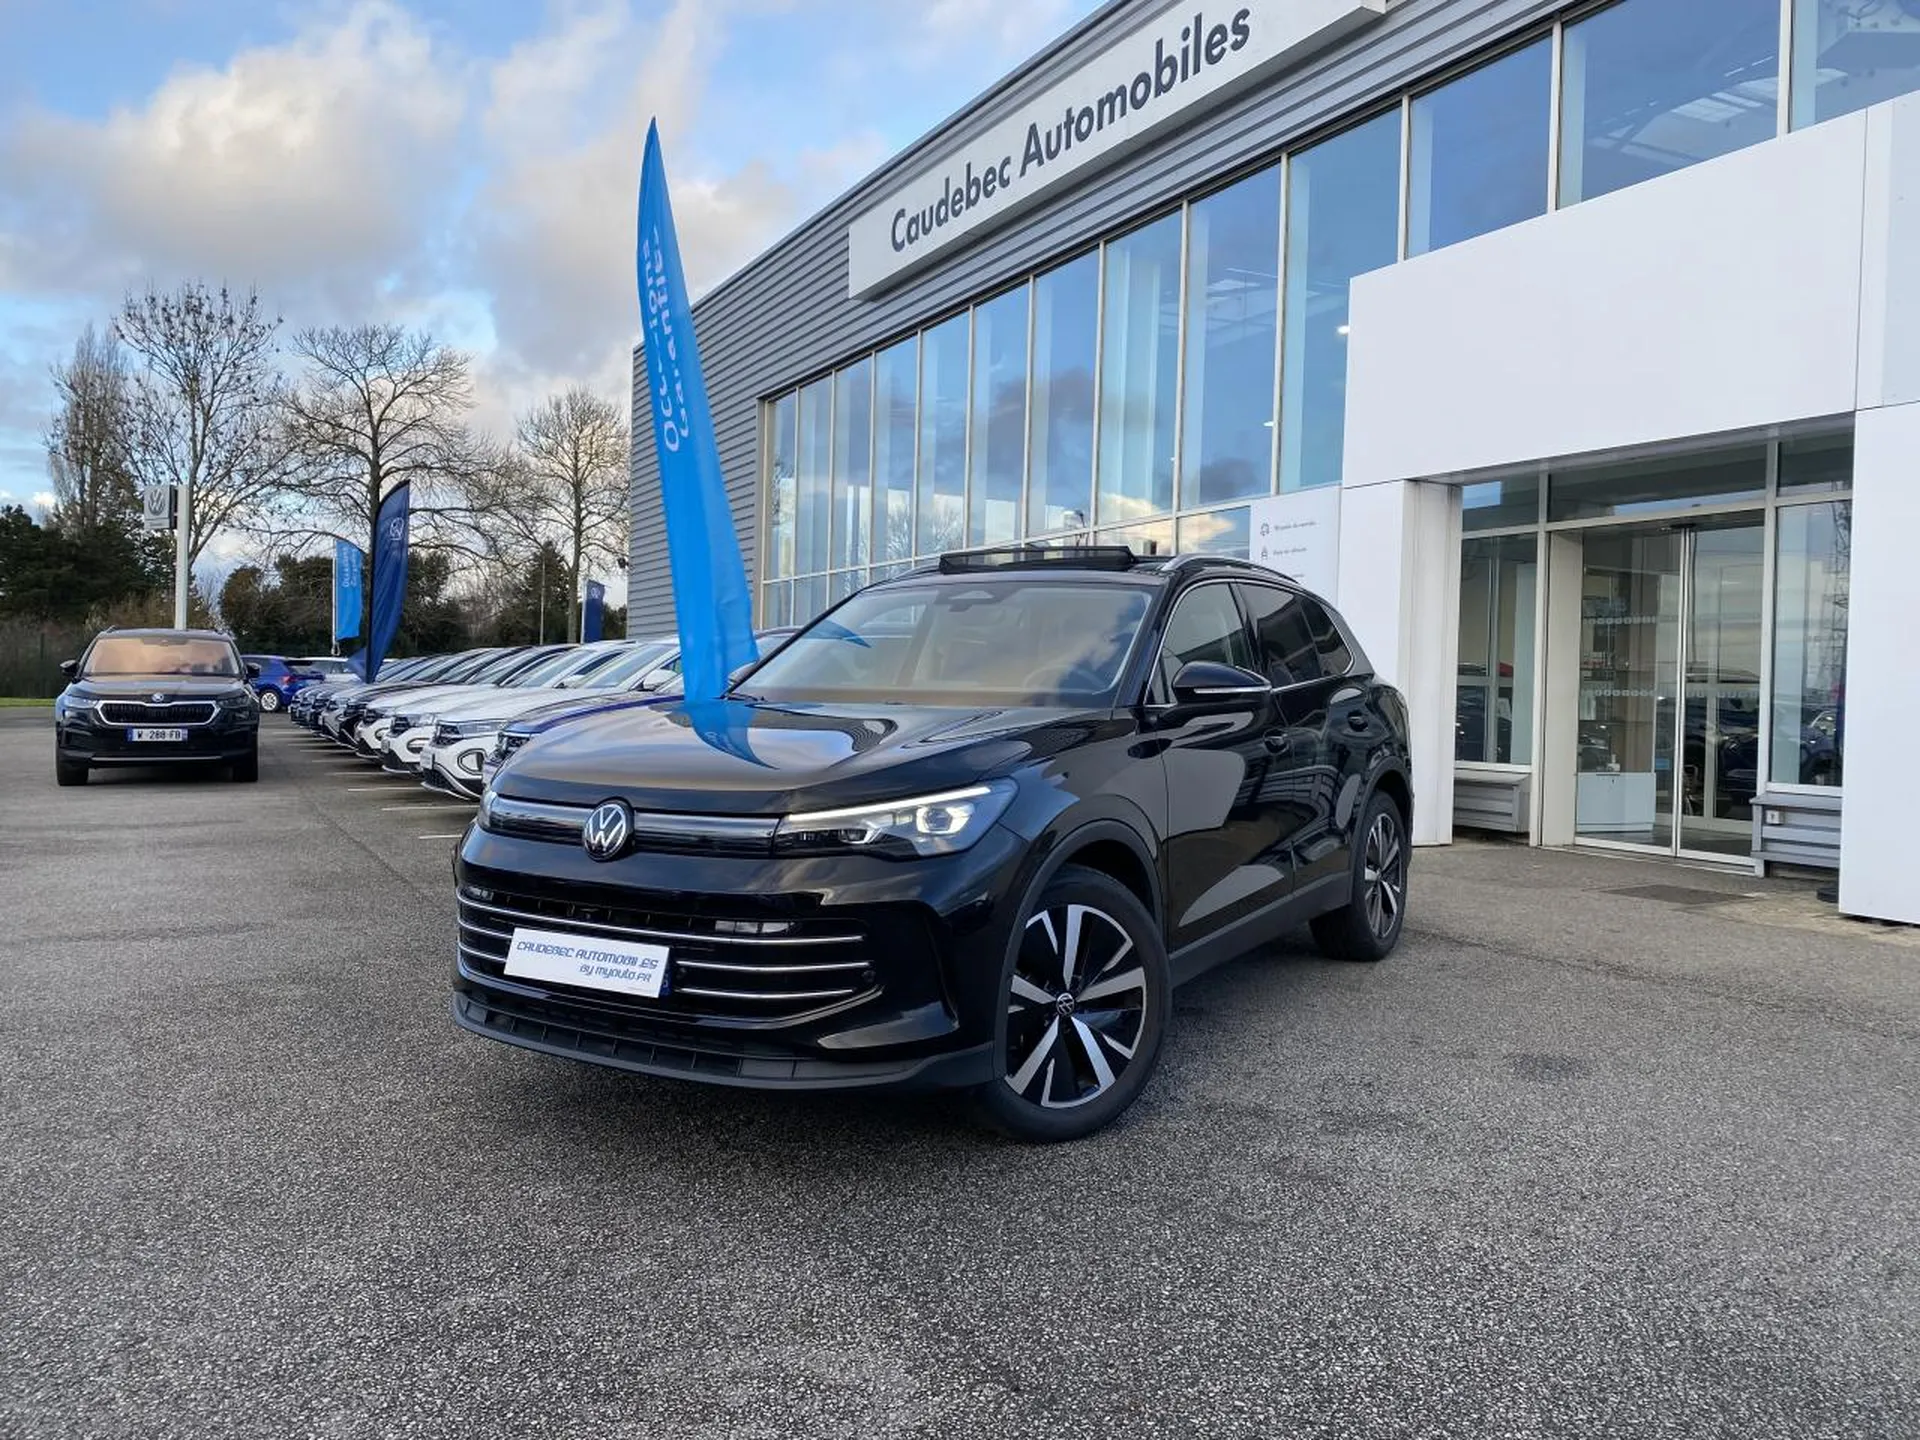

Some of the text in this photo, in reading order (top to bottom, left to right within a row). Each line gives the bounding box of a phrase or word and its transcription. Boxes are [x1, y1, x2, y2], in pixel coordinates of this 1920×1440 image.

[891, 8, 1250, 252] Caudebec Automobiles
[517, 941, 575, 958] CAUDEBEC
